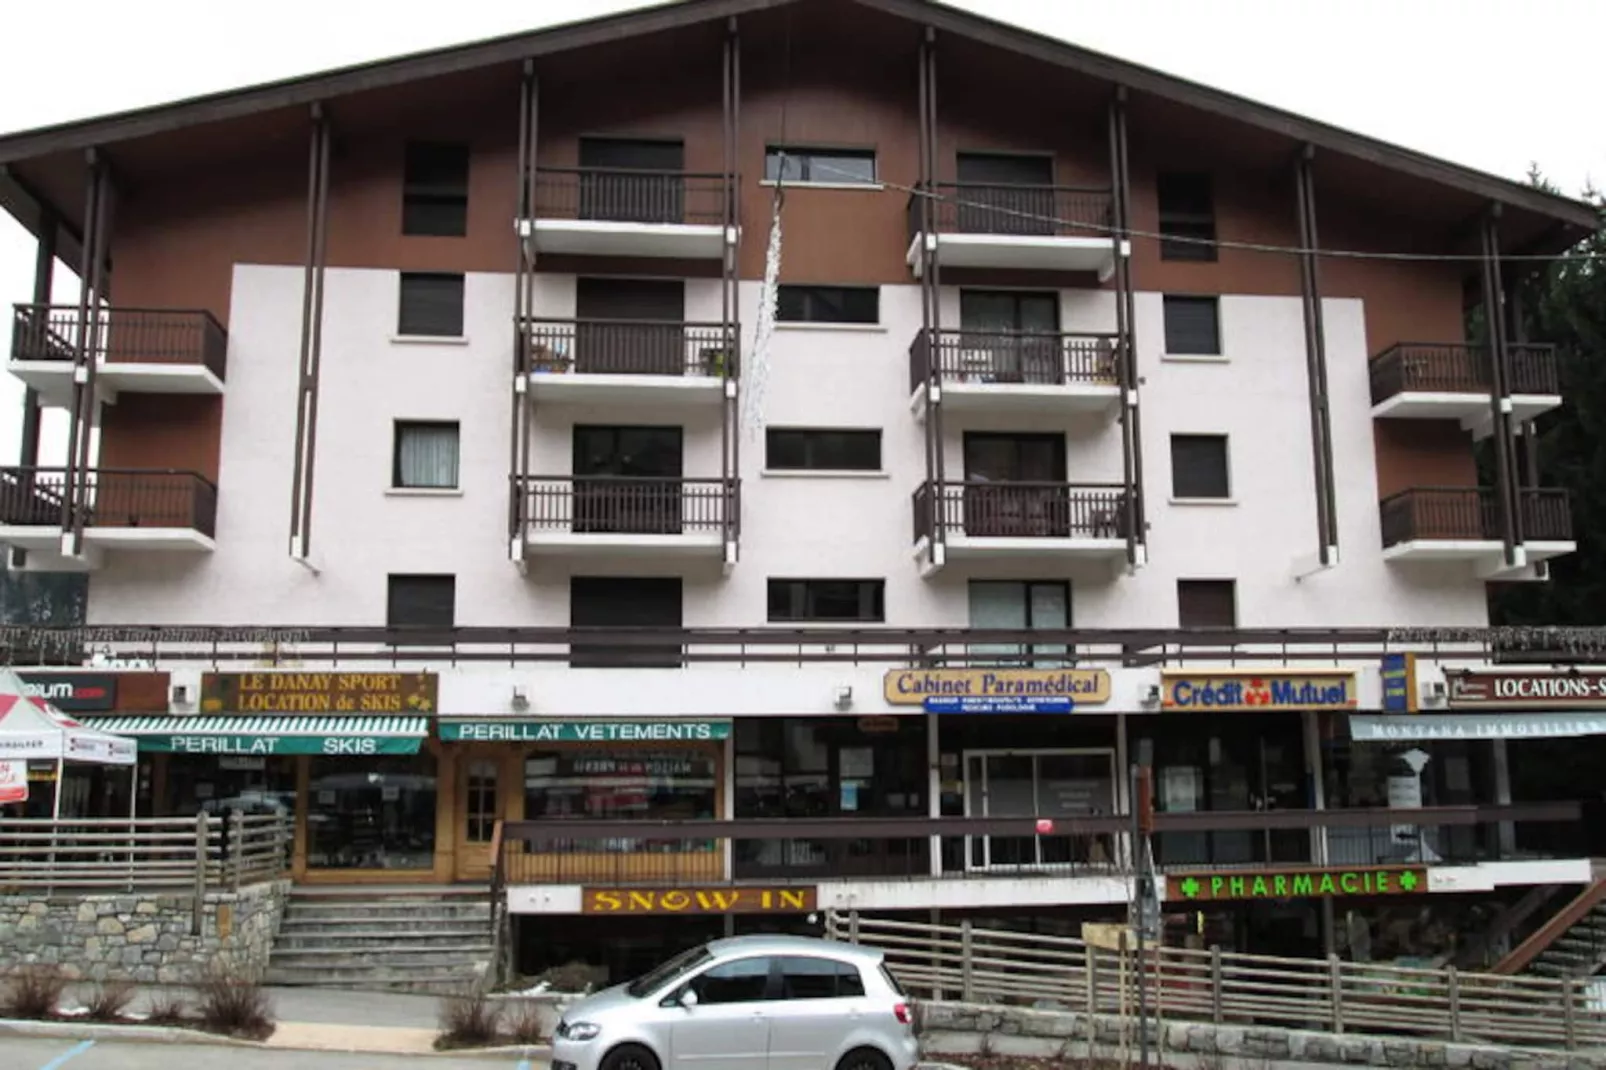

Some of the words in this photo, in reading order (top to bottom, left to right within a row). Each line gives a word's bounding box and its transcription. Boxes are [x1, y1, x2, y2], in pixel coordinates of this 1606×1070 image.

[240, 674, 264, 690] LE
[271, 674, 332, 690] DANAY
[338, 674, 400, 690] SPORT
[897, 674, 972, 694] Cabinet
[982, 674, 1099, 694] Paramédical
[1173, 680, 1243, 706] Crédit
[1270, 679, 1347, 706] Mutuel
[238, 693, 330, 711] LOCATION
[336, 694, 353, 710] de
[360, 693, 401, 711] SKIS
[458, 724, 564, 741] PERILLAT
[574, 723, 711, 740] VETEMENTS
[1371, 724, 1465, 738] MONTANA
[171, 736, 279, 753] PERILLAT
[322, 737, 377, 754] SKIS
[1211, 871, 1389, 897] PHARMACIE
[593, 890, 739, 911] SNOW
[761, 889, 805, 910] IN
